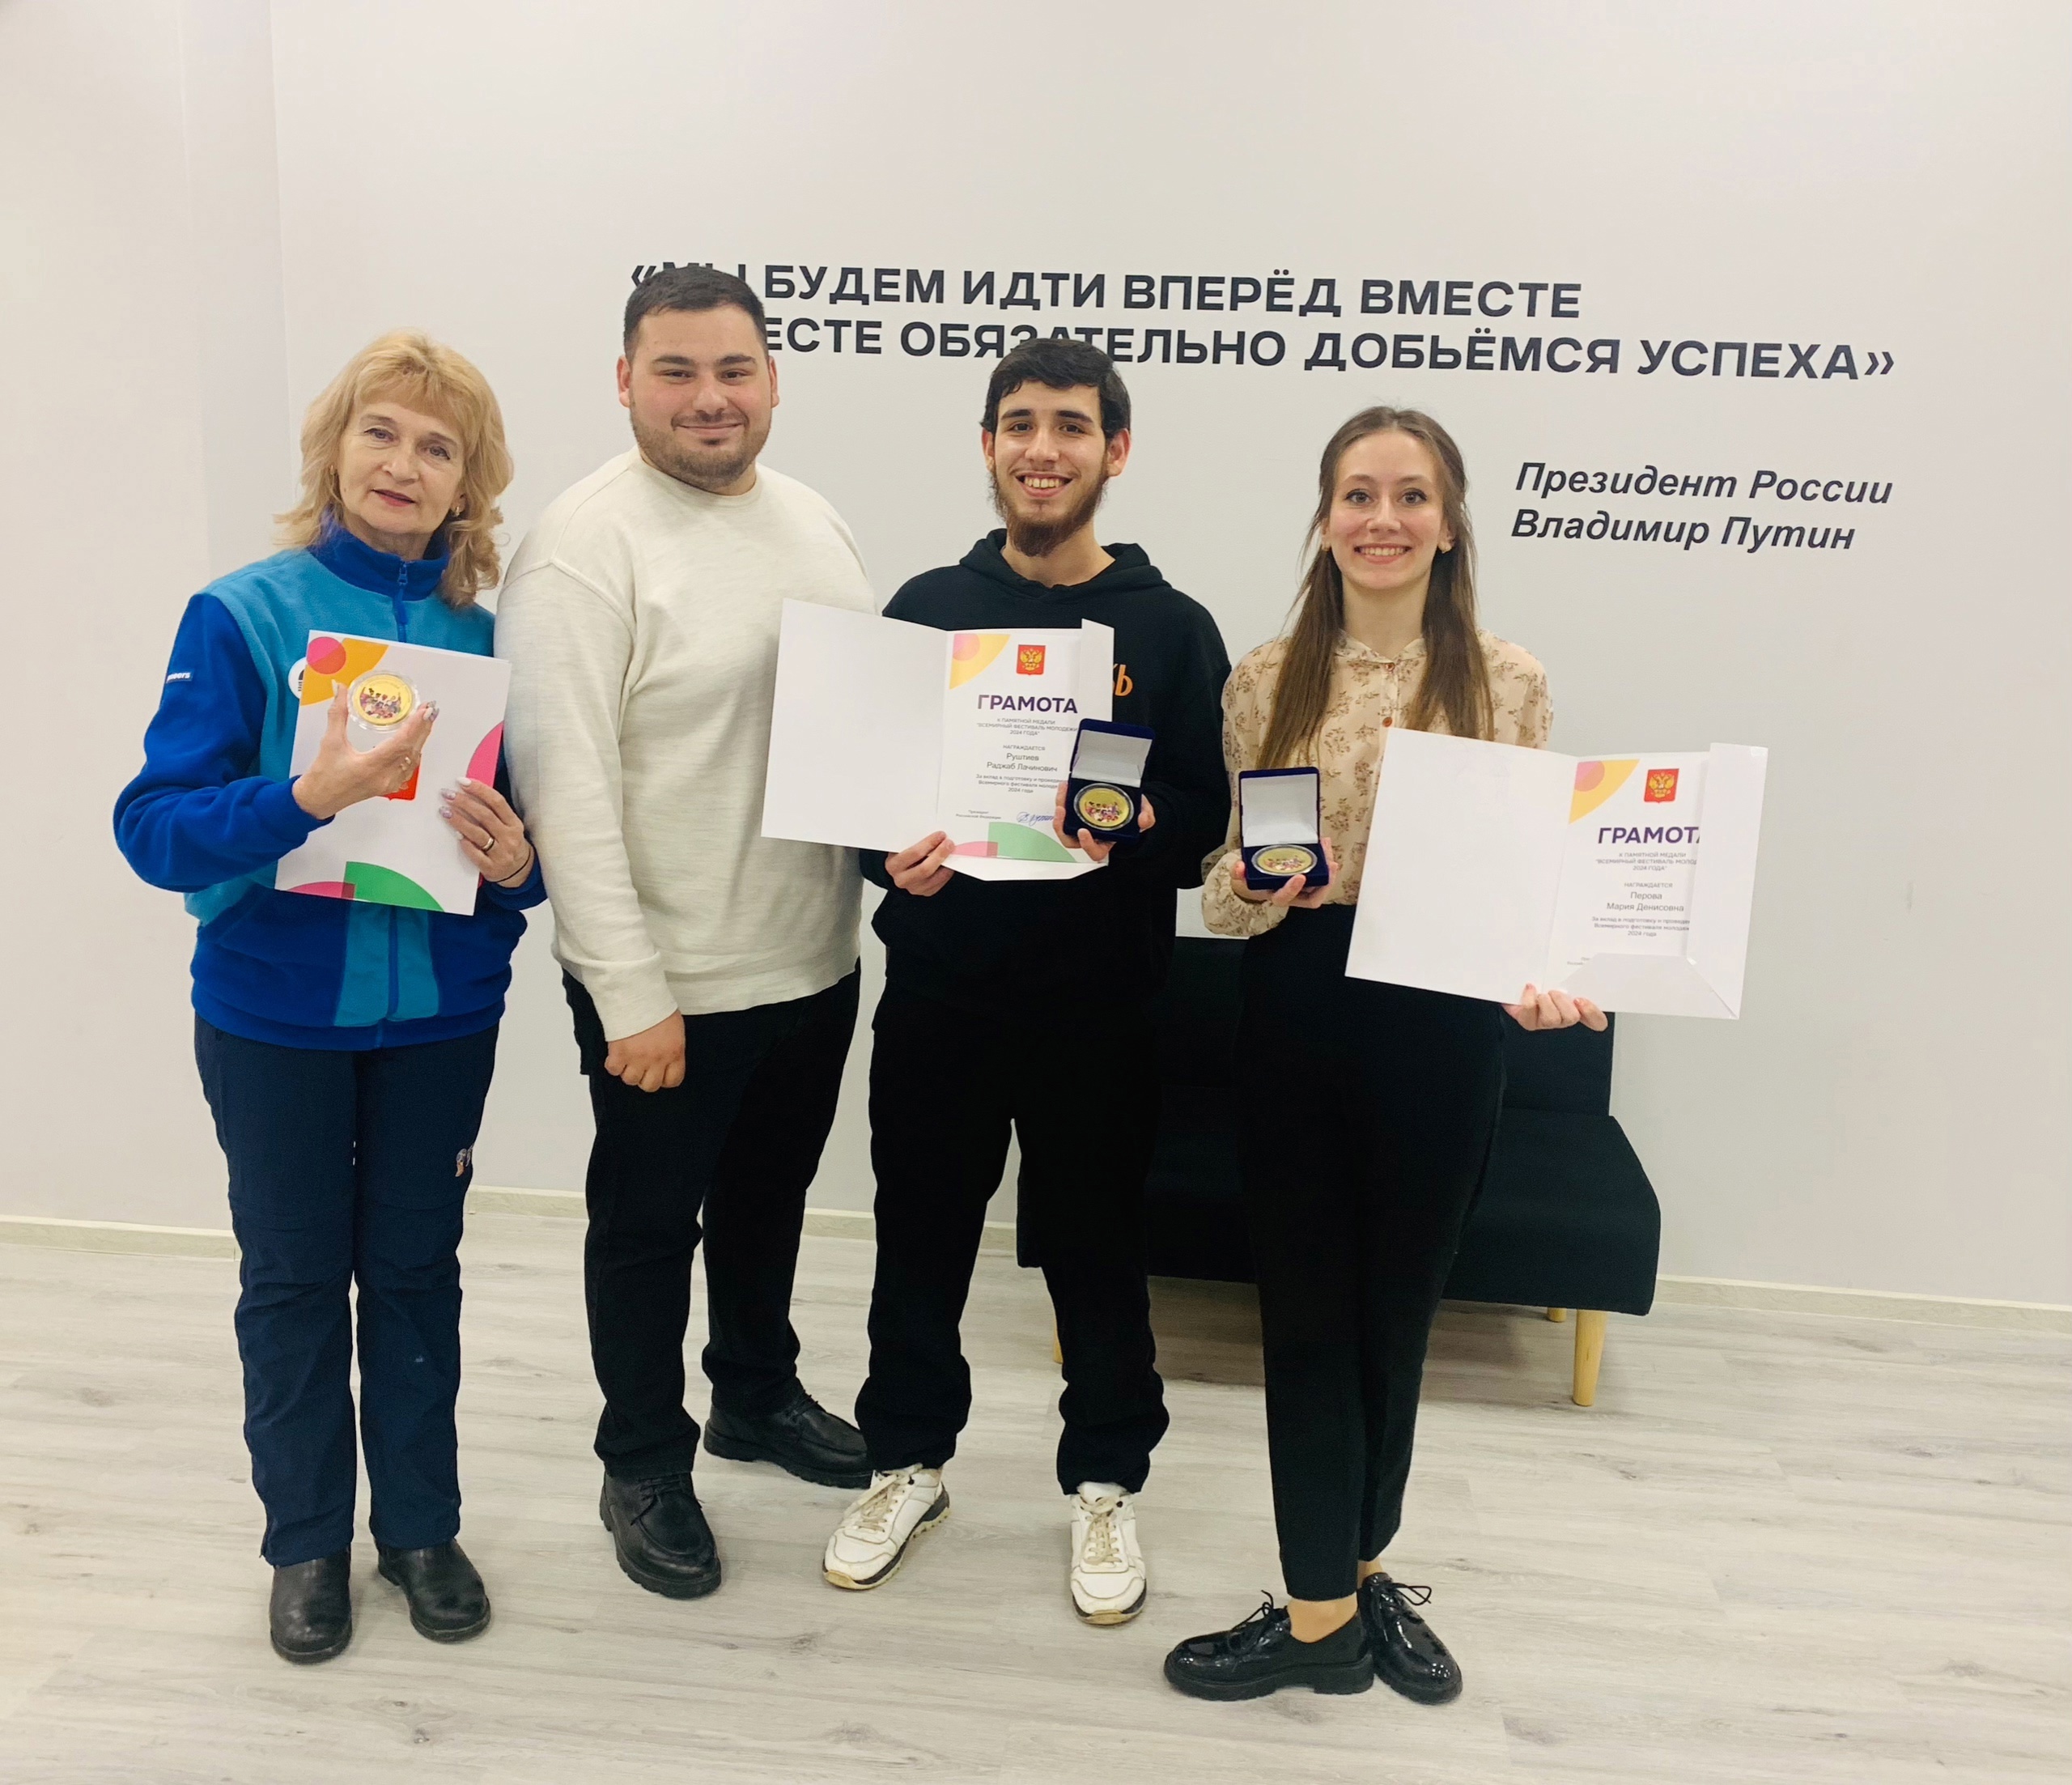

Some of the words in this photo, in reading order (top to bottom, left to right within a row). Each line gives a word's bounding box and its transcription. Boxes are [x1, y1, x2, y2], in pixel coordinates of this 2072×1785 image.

[765, 264, 945, 307] БУДЕМ
[963, 270, 1106, 311] ИДТИ
[1123, 269, 1342, 318] ВПЕРЁД
[1360, 278, 1582, 318] ВМЕСТЕ
[765, 317, 882, 355] ЕСТЕ
[1304, 327, 1620, 374] ДОБЬЁМСЯ
[1637, 339, 1895, 380] УСПЕХА»
[1515, 461, 1738, 499] Президент
[1748, 470, 1893, 504] России
[1510, 508, 1709, 551] Владимир
[1721, 516, 1856, 554] Путин
[977, 694, 1078, 713] ГРАМОТА
[986, 761, 1017, 770] Раджаб
[1597, 826, 1700, 844] ГРАМОТ
[1630, 890, 1663, 900] Перова
[1606, 902, 1635, 912] Мария
[1636, 903, 1685, 912] Денисовна
